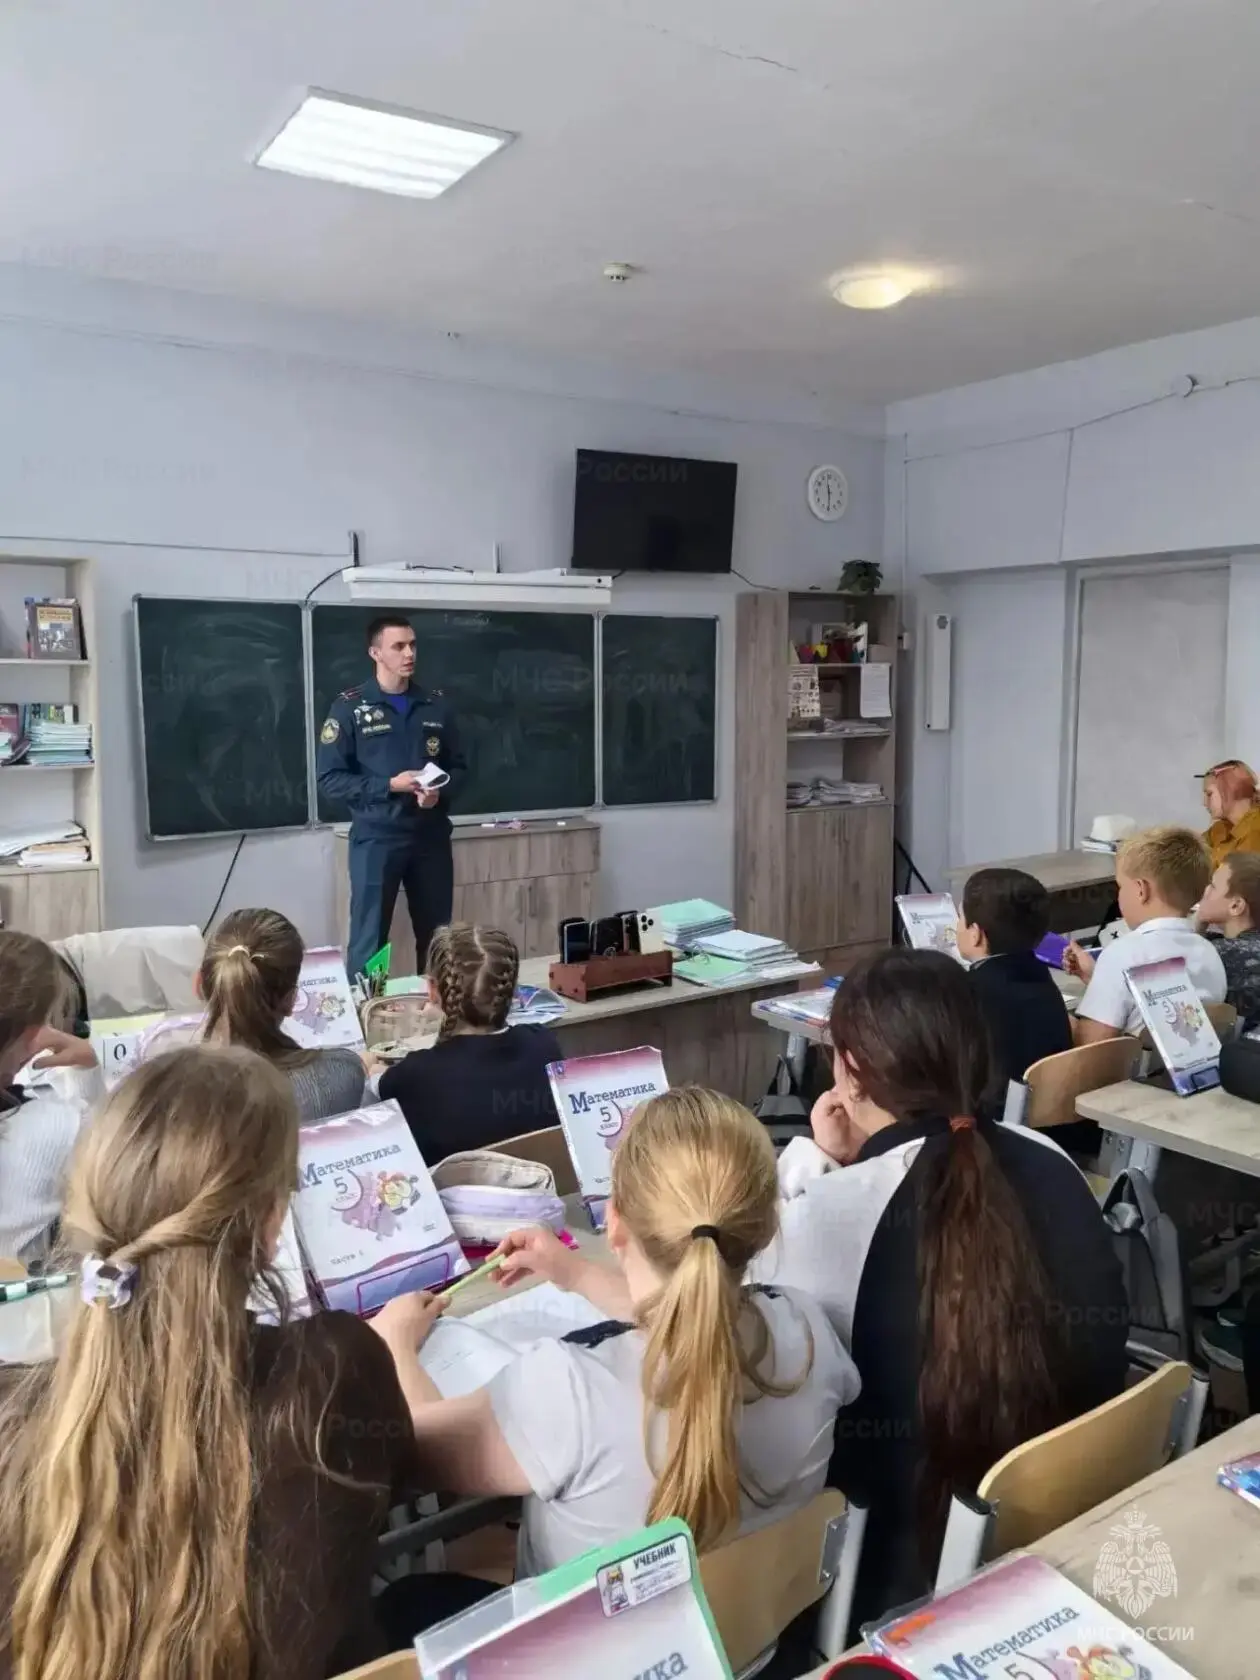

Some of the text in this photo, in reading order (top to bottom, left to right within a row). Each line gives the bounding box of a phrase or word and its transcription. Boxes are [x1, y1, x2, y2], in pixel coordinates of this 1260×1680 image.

[568, 1082, 656, 1115] Математика
[600, 1106, 612, 1122] 5
[299, 1143, 402, 1190] Математика
[333, 1176, 349, 1195] 5
[633, 1543, 677, 1570] УЧЕБНИК
[934, 1606, 1080, 1680] Математика
